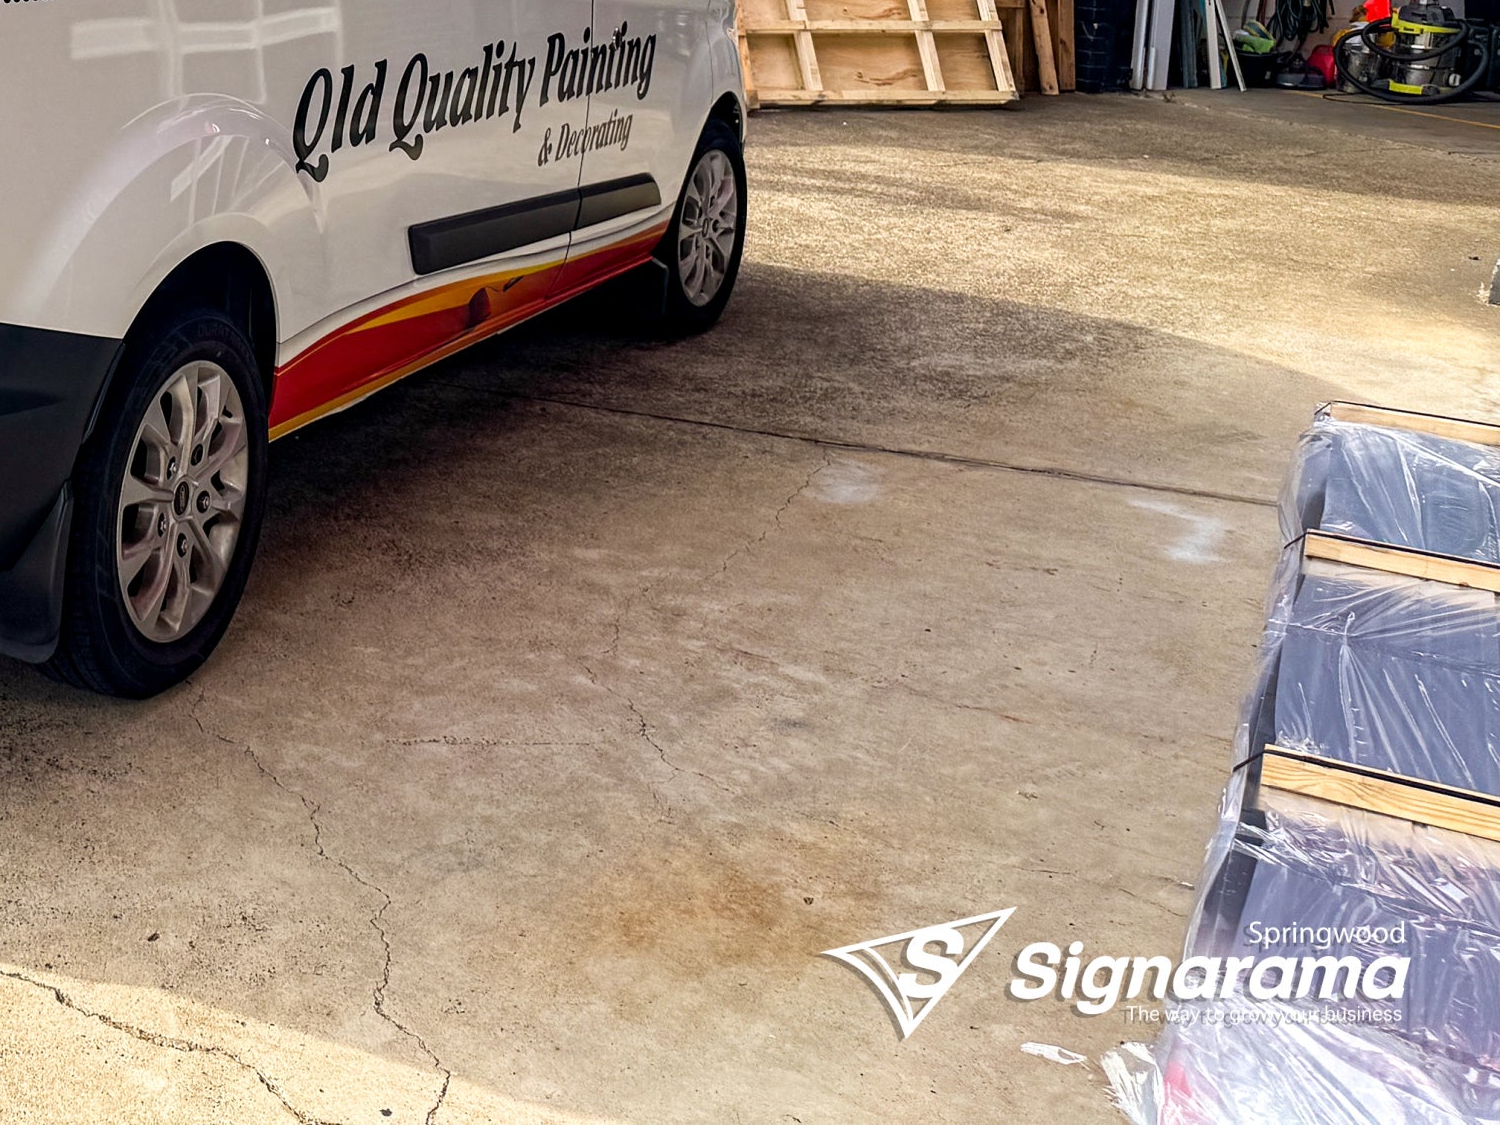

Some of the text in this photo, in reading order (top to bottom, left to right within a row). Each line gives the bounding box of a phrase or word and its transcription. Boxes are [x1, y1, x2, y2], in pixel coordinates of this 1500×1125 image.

[292, 20, 657, 183] Qld Quality Painting
[537, 108, 634, 167] & Decorating
